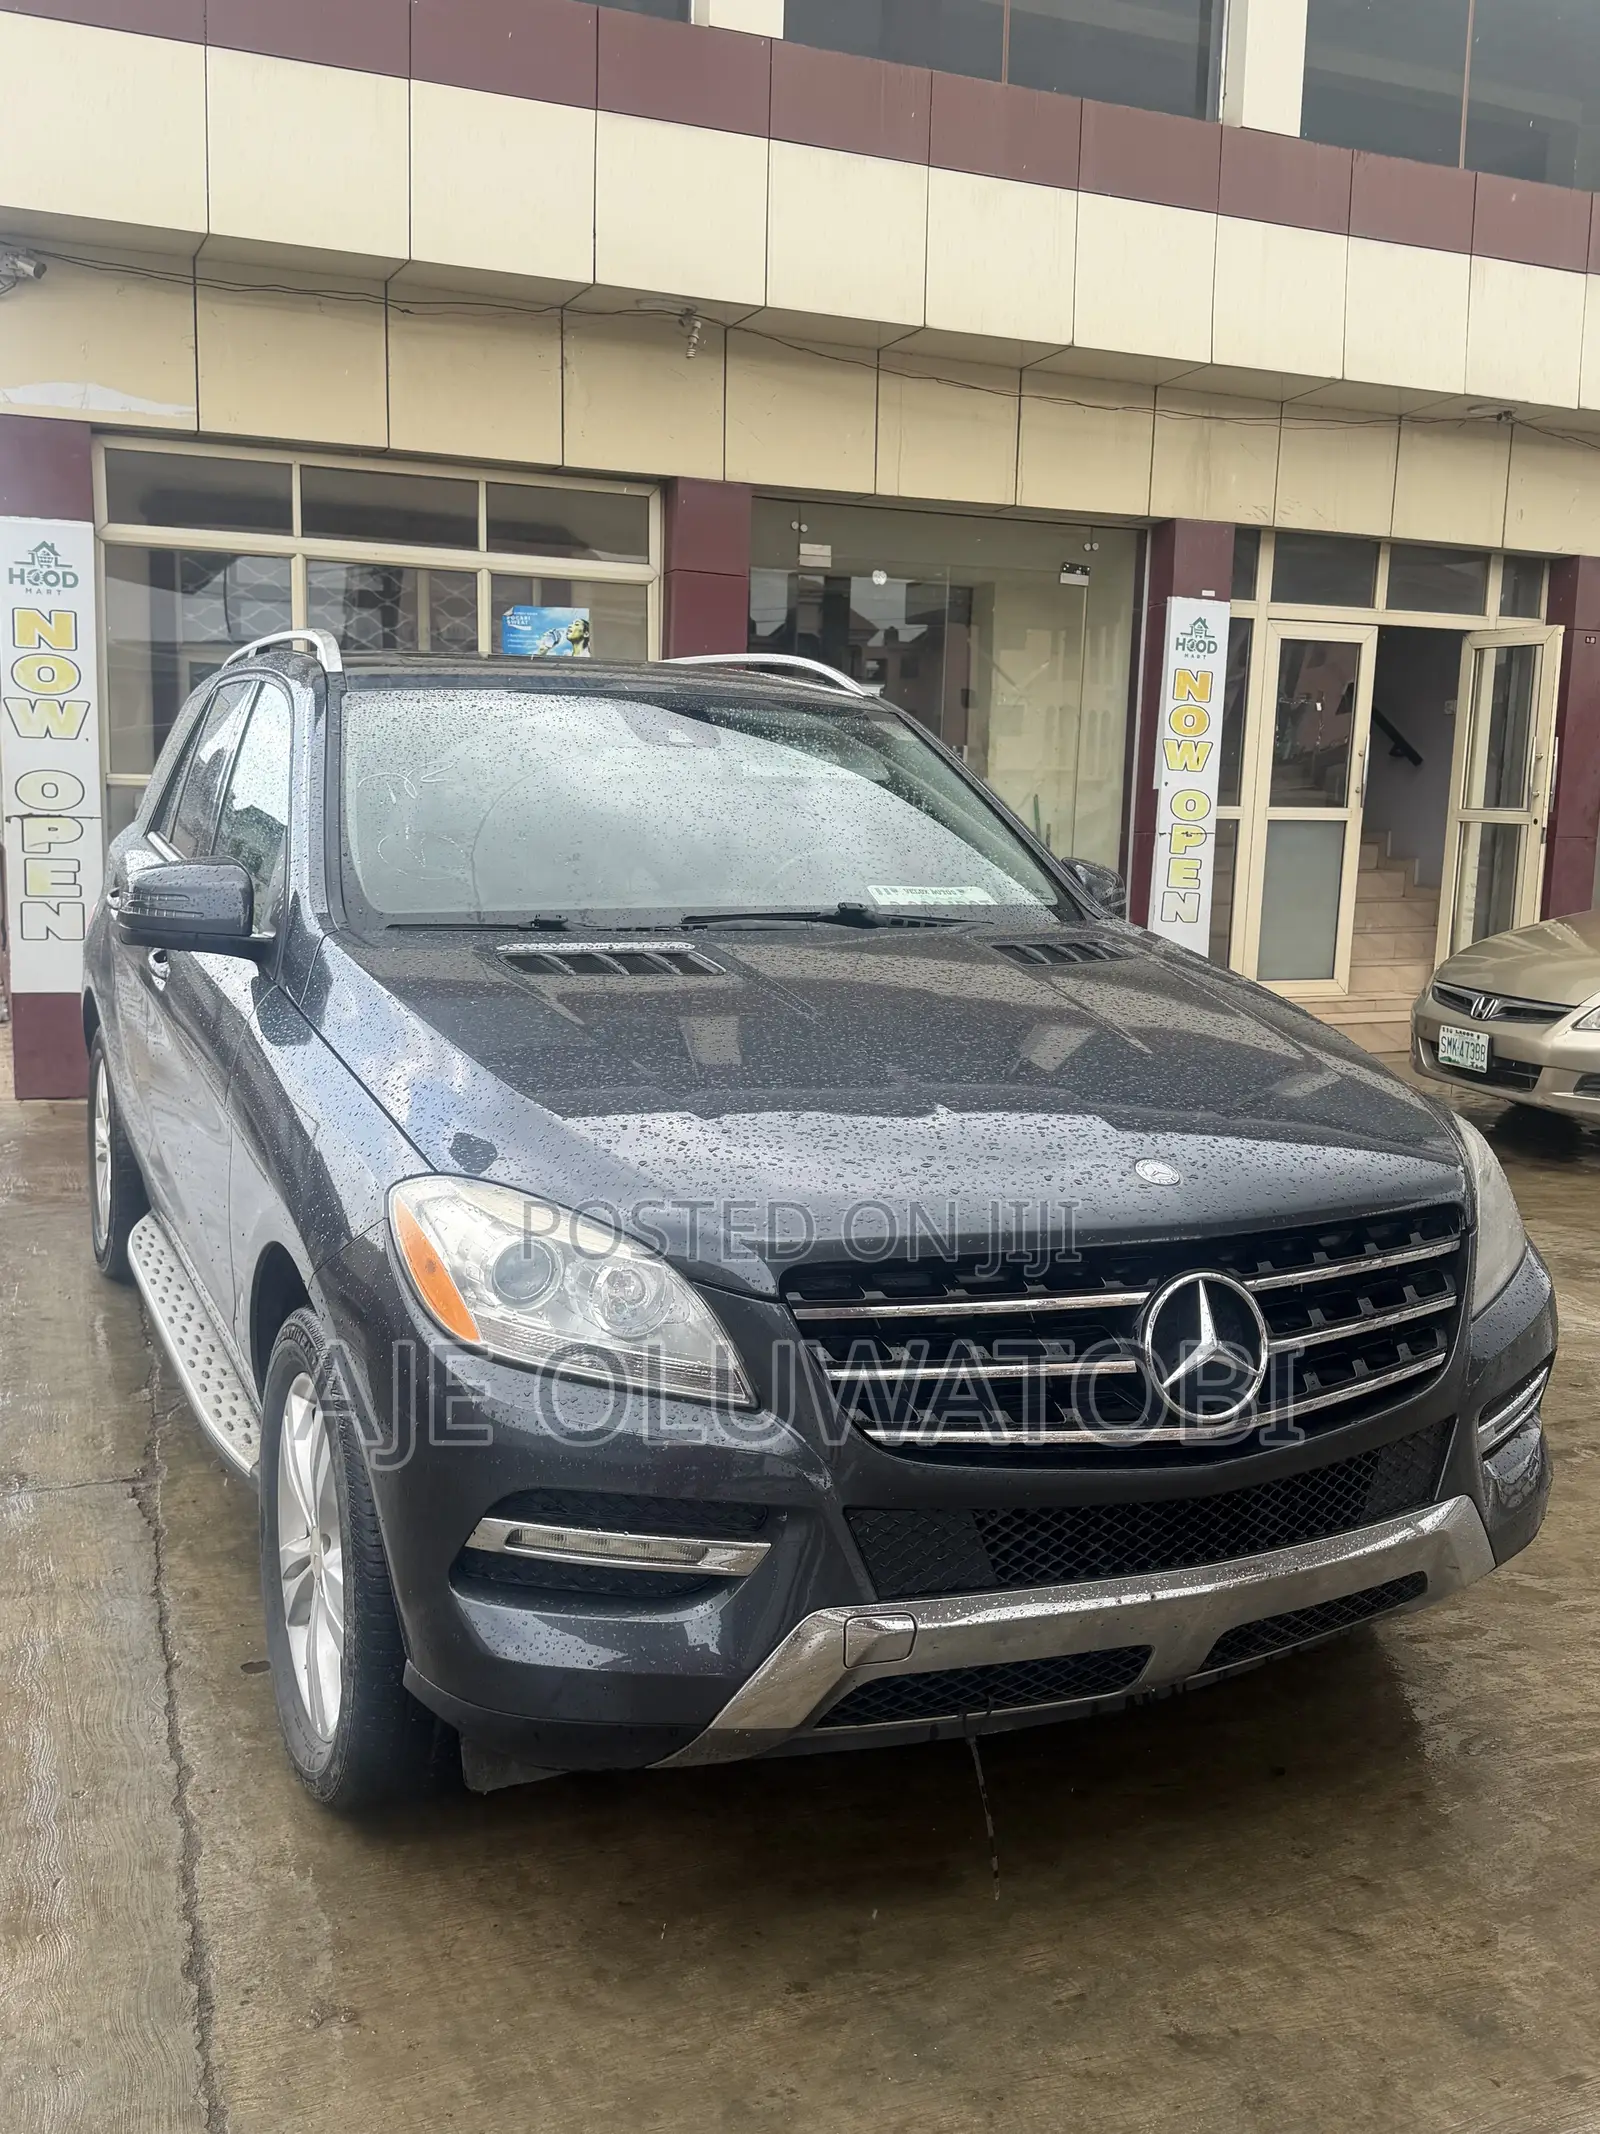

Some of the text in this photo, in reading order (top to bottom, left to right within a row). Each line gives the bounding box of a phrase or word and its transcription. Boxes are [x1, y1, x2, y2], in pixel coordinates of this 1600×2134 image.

[8, 567, 79, 589] HOOD
[25, 588, 62, 596] MART
[1175, 637, 1218, 654] HOOD
[3, 607, 91, 941] NOW OPEN
[1160, 668, 1213, 924] NOW OPEN
